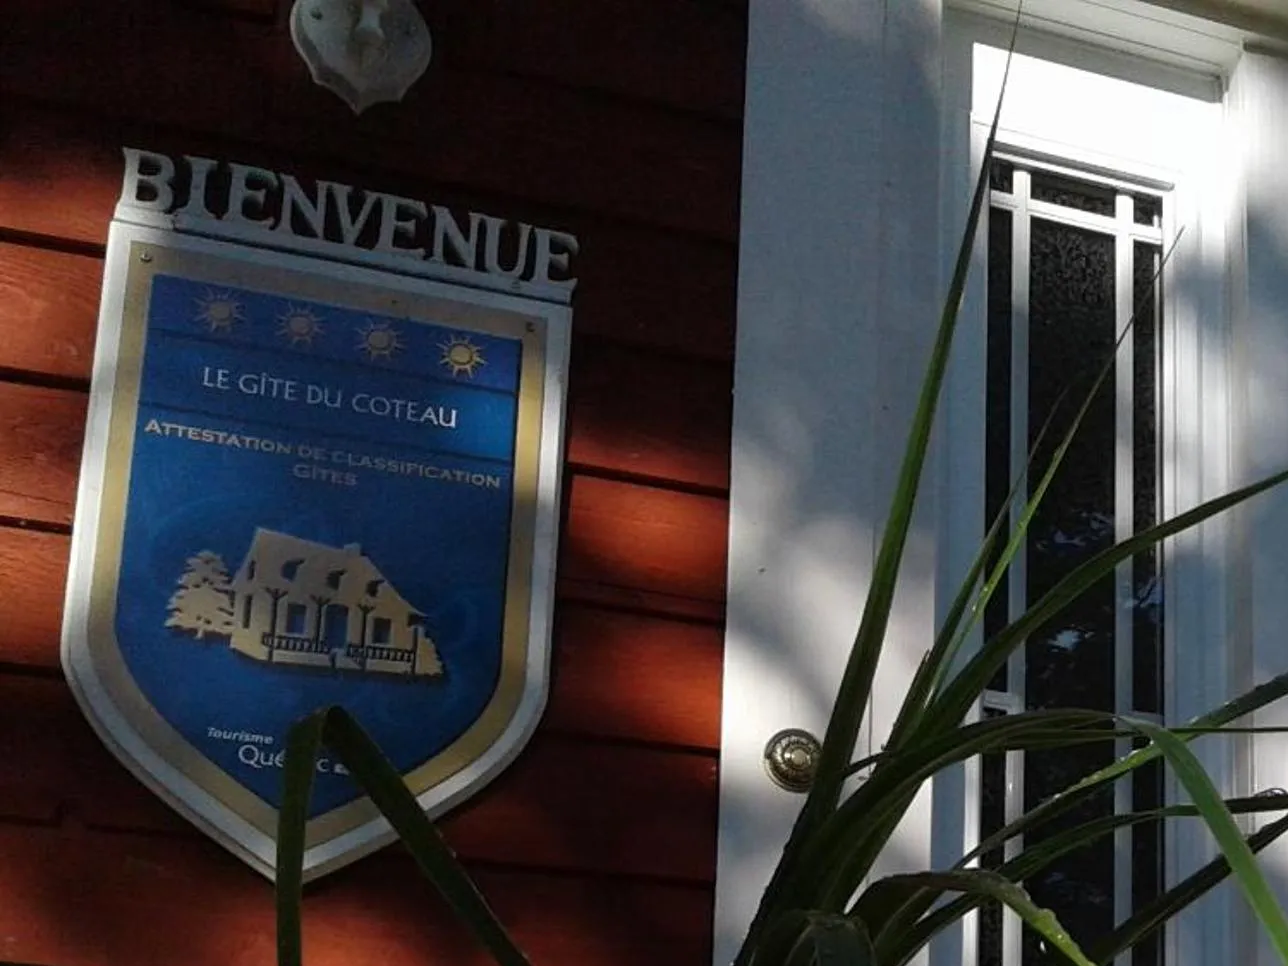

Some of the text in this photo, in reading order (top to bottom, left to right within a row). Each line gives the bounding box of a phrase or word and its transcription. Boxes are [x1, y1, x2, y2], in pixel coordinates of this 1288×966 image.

[122, 147, 578, 285] BIENVENUE
[203, 366, 230, 390] LE
[306, 384, 342, 408] DU
[352, 393, 458, 428] COTEAU
[144, 419, 501, 489] ATTESTATION DE CLASSIFICATION
[207, 727, 274, 745] Tourisme
[238, 744, 329, 773] Quéc
